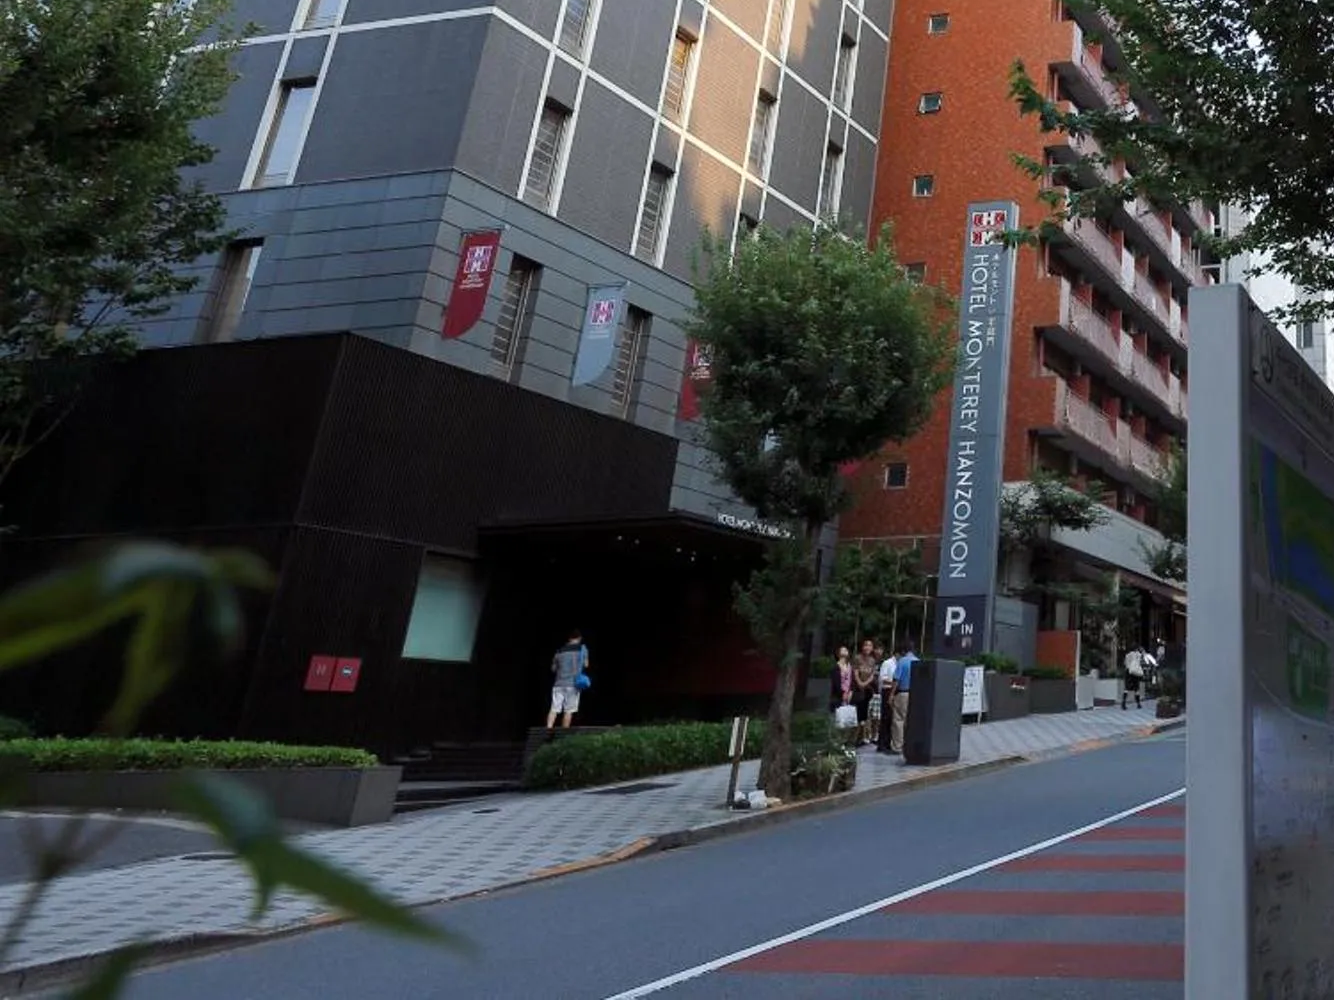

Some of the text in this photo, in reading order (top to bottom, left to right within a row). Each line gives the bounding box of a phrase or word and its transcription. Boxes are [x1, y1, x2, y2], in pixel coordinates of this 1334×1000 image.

[950, 254, 989, 578] HOTEL MONTEREY HANZOMON
